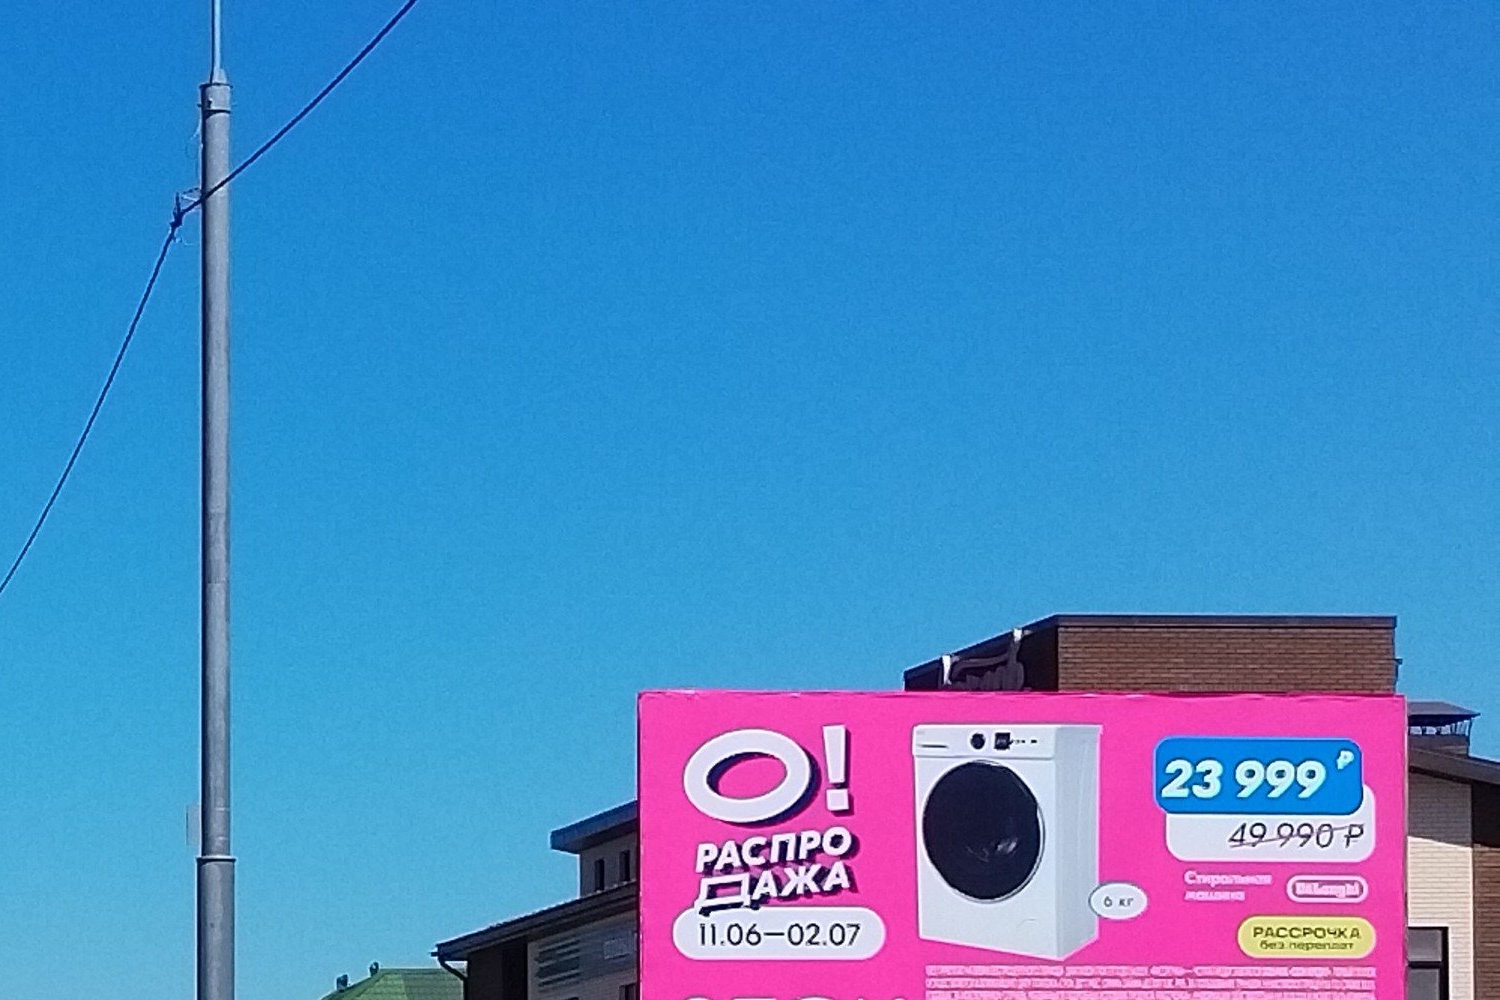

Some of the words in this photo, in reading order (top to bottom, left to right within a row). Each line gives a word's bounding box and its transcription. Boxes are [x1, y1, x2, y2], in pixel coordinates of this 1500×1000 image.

[1161, 758, 1224, 799] 23
[1234, 759, 1327, 799] 999
[1227, 822, 1268, 848] 49
[1276, 822, 1334, 849] 990
[695, 826, 853, 874] РАСПРО
[693, 860, 851, 912] ДАЖА
[1103, 895, 1113, 908] 6
[1118, 897, 1134, 907] кг
[1252, 926, 1362, 939] РАССРОЧКА
[1259, 940, 1286, 950] без
